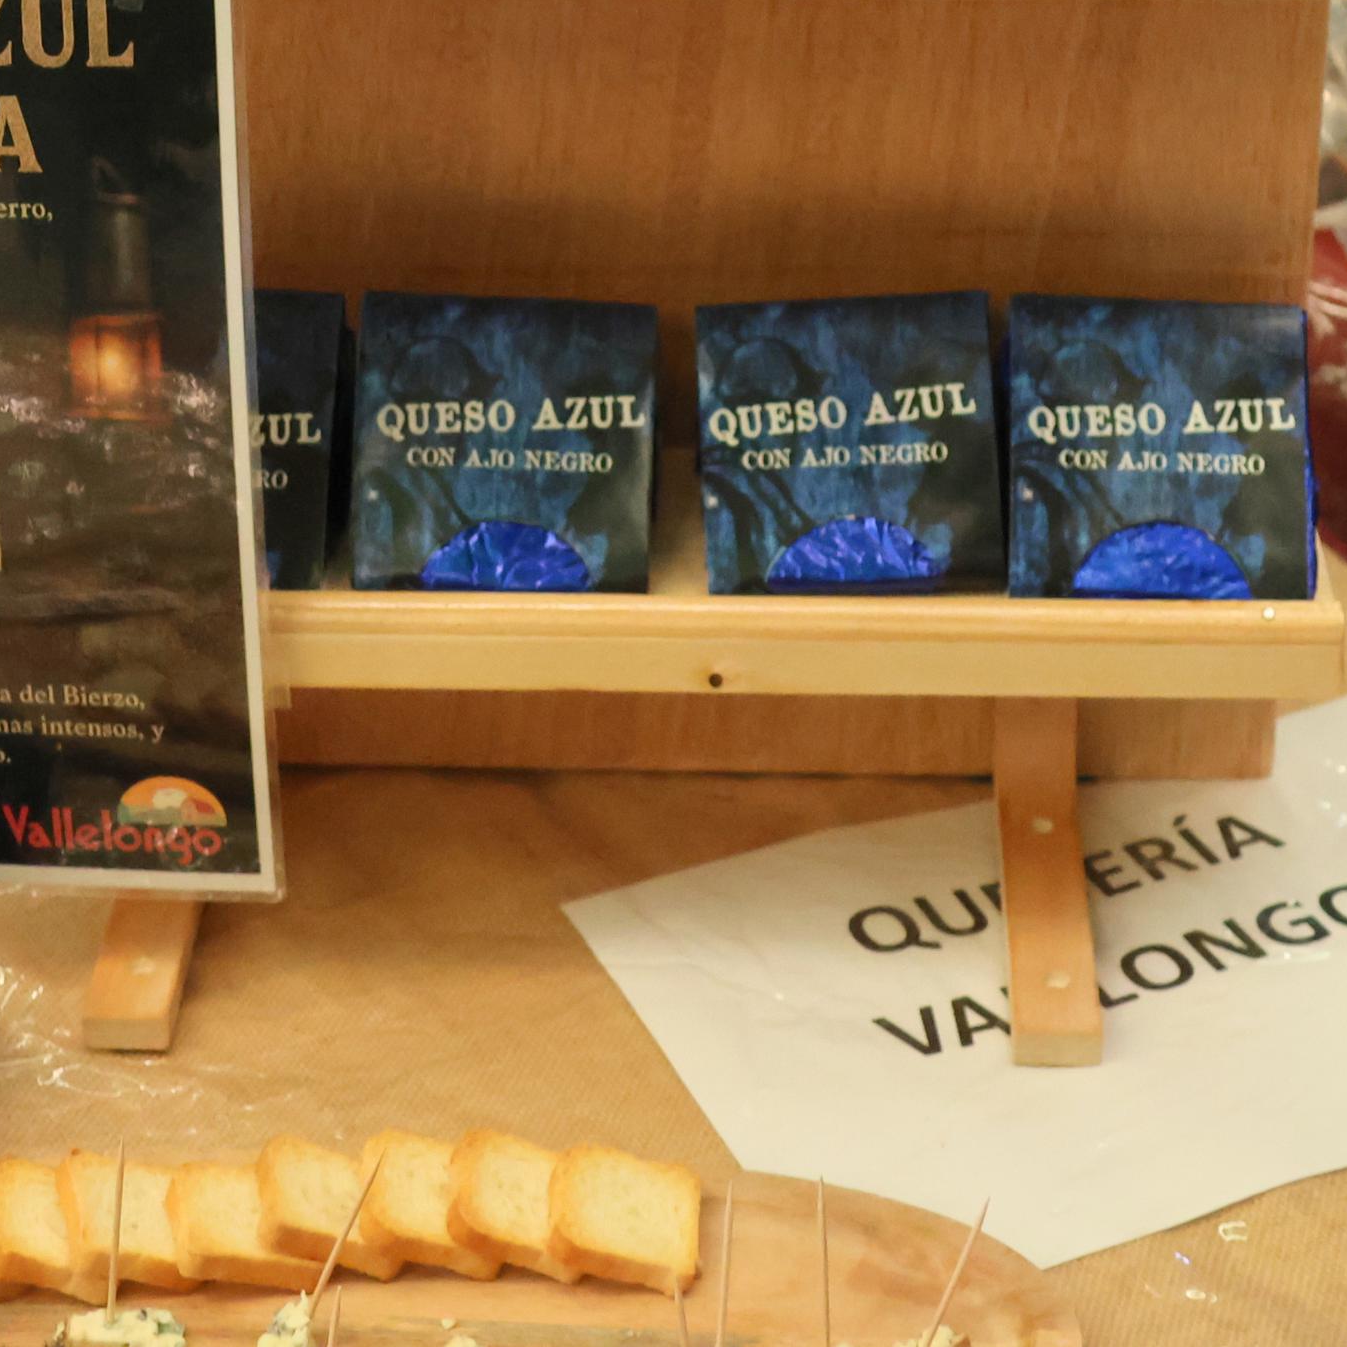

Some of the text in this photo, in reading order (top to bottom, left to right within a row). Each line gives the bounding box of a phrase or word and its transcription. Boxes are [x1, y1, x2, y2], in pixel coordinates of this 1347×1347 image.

[376, 395, 645, 441] QUESO AZUL
[709, 382, 976, 447] QUESO AZUL
[1028, 398, 1295, 445] QUESO AZUL
[406, 447, 613, 474] CON AJO NEGRO
[742, 441, 948, 471] CON AJO NEGRO
[1059, 449, 1265, 476] CON AJO NEGRO
[19, 684, 54, 705] del
[63, 684, 145, 710] Bierzo,
[41, 715, 144, 740] intensos,
[152, 724, 164, 744] y
[2, 805, 222, 866] Vallelongo
